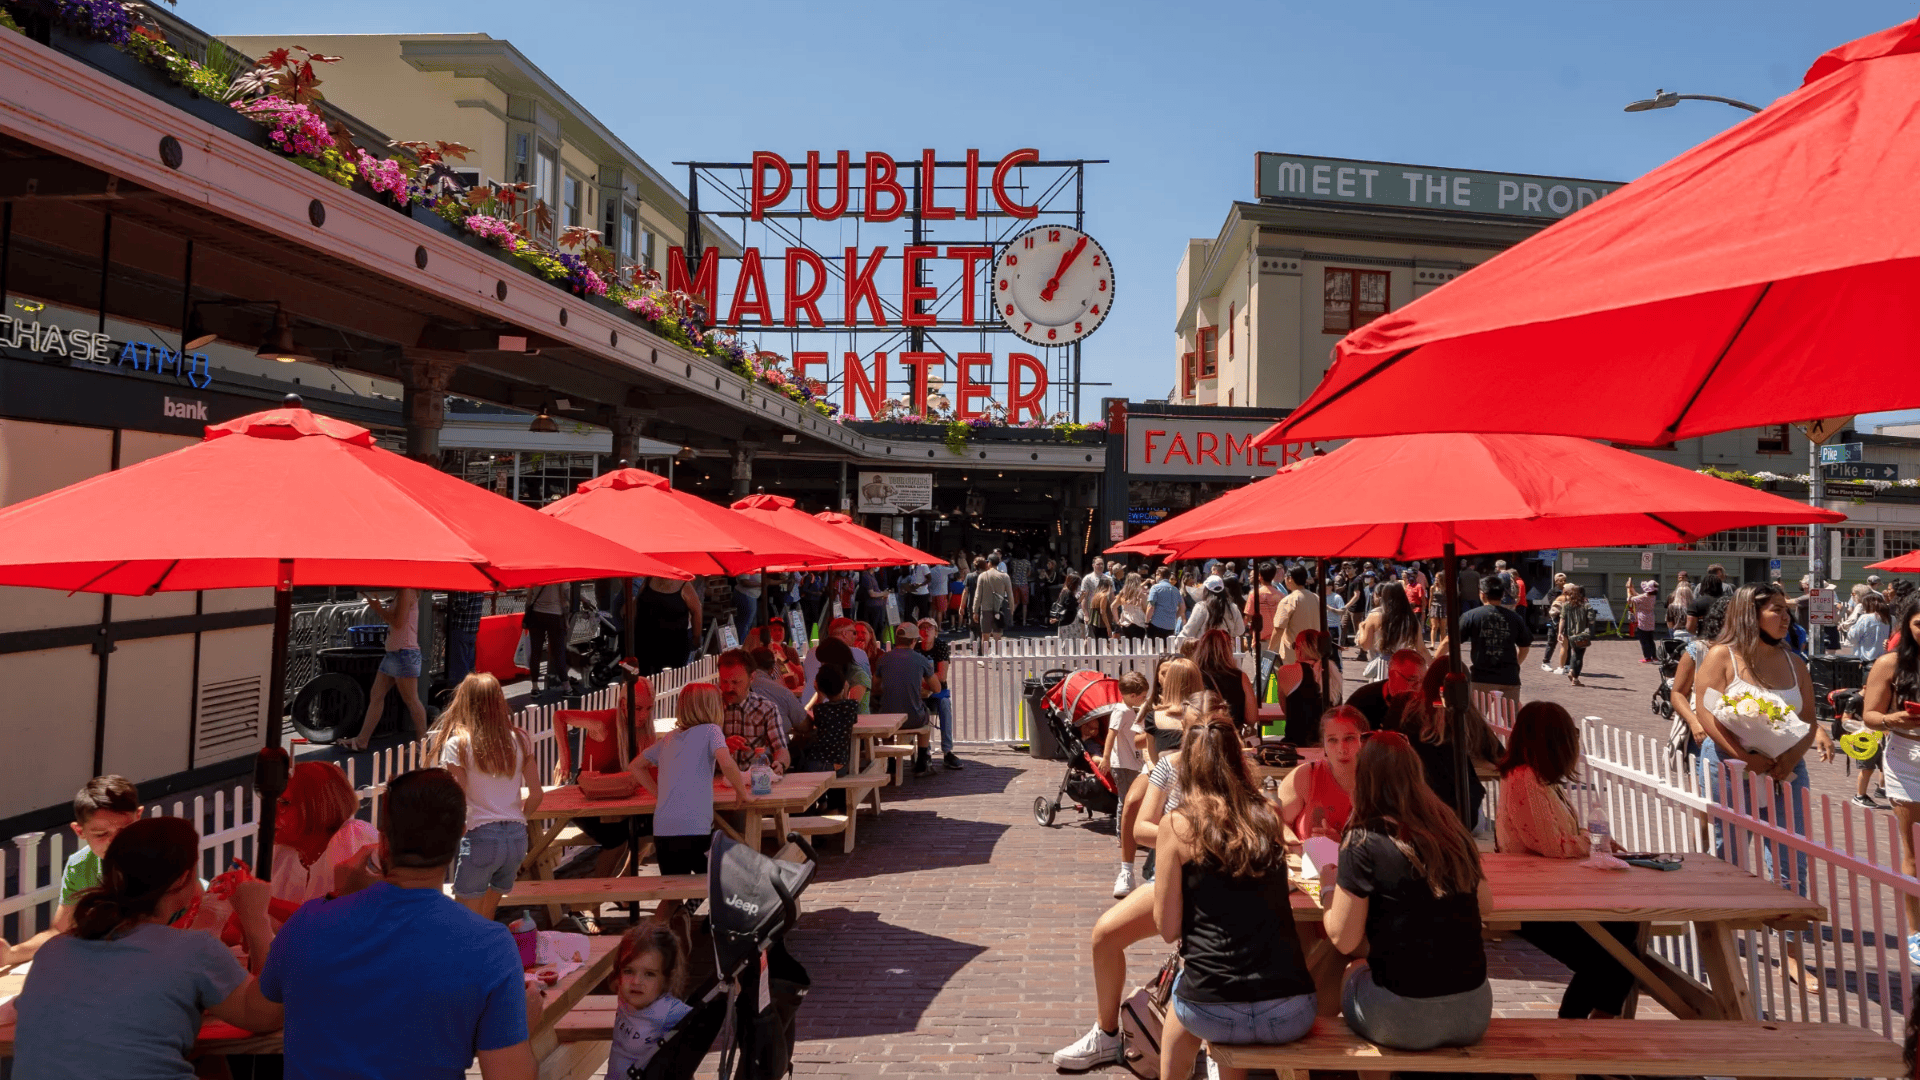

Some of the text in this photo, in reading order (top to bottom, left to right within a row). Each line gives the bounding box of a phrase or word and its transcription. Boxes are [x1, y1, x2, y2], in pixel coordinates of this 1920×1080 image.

[751, 148, 1040, 223] PUBLIC
[1278, 161, 1610, 214] MEET THE PROD
[1048, 230, 1061, 242] 12
[1025, 237, 1034, 249] 11
[1006, 255, 1018, 266] 10
[1093, 255, 1101, 266] 2
[667, 246, 993, 327] MARKET
[999, 280, 1008, 291] 9
[1098, 280, 1107, 291] 3
[1005, 304, 1015, 316] 8
[1090, 305, 1100, 315] 4
[1023, 322, 1033, 333] 7
[1074, 322, 1083, 333] 5
[1047, 328, 1057, 340] 6
[118, 340, 182, 377] ATM
[164, 396, 209, 421] bank
[1823, 447, 1838, 460] Pike
[1830, 463, 1875, 477] Pike Pl
[726, 894, 759, 915] Jeep
